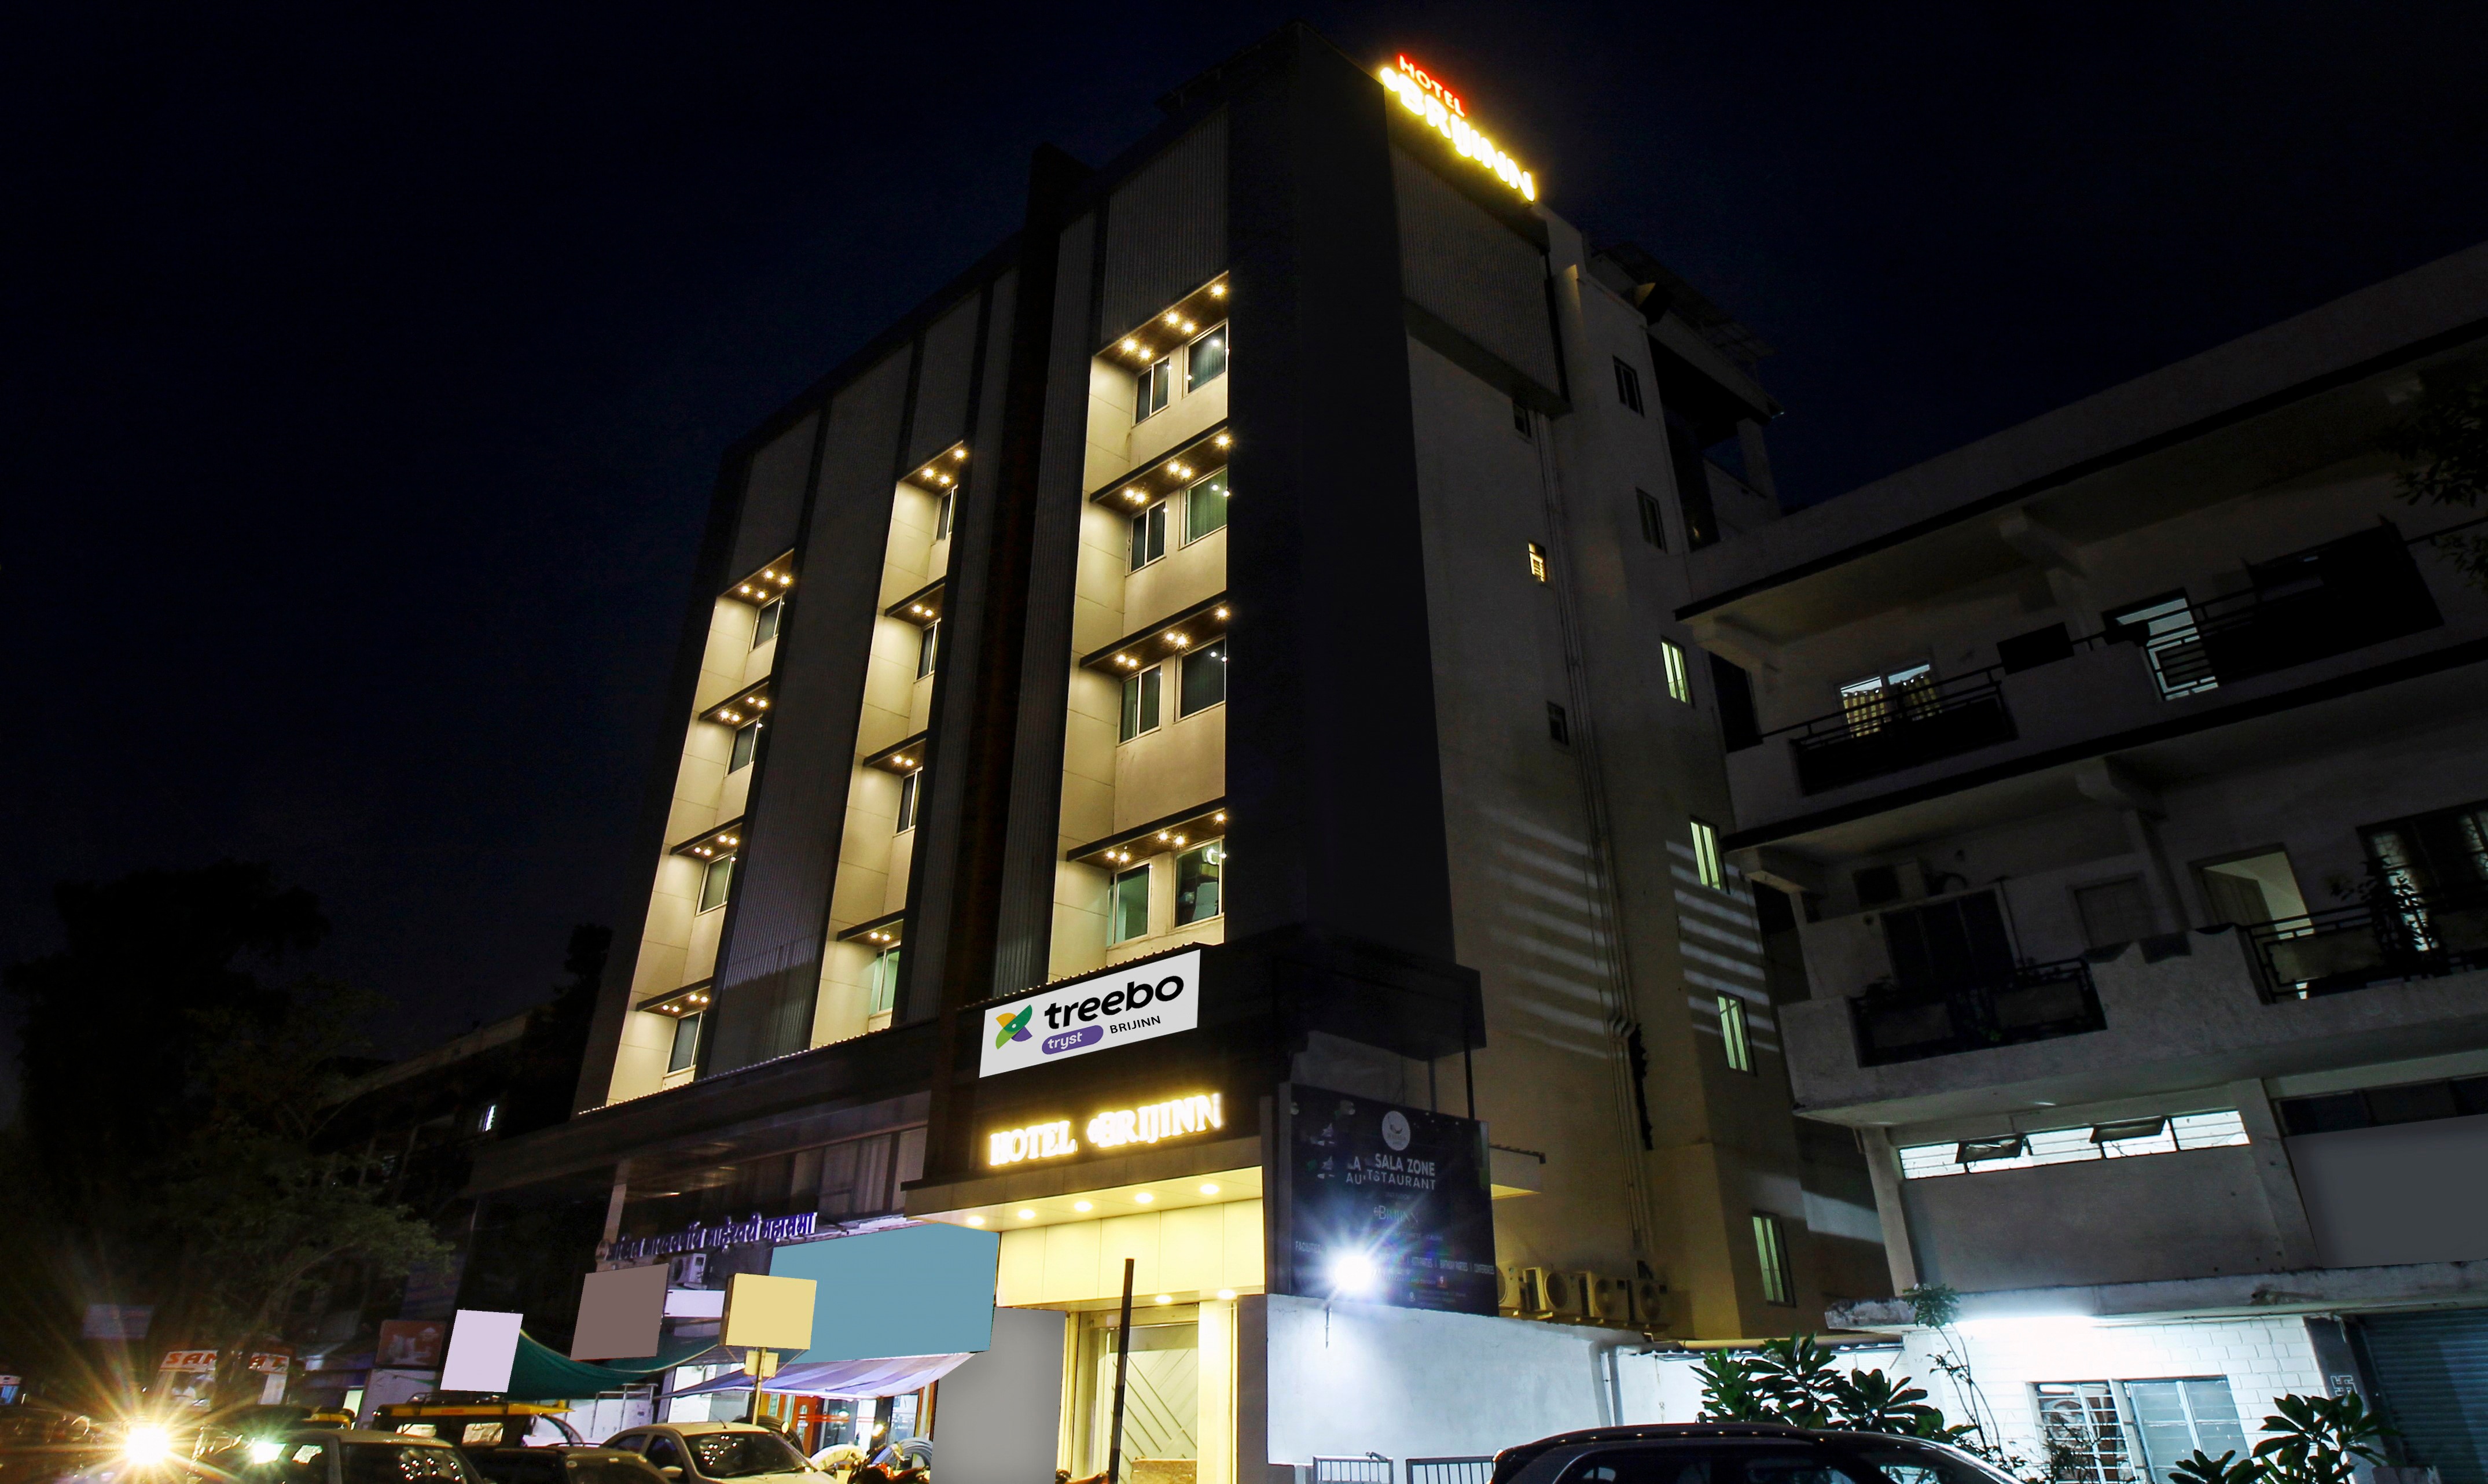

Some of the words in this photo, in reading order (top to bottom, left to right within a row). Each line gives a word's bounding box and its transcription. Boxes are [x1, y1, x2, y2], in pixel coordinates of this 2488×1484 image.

[1399, 54, 1465, 117] HOTEL
[1045, 975, 1184, 1029] treebo
[1048, 1032, 1083, 1050] tryst
[1110, 1015, 1161, 1034] BRIJINN
[990, 1120, 1078, 1166] HOTEL
[1407, 1158, 1435, 1177] ZONE
